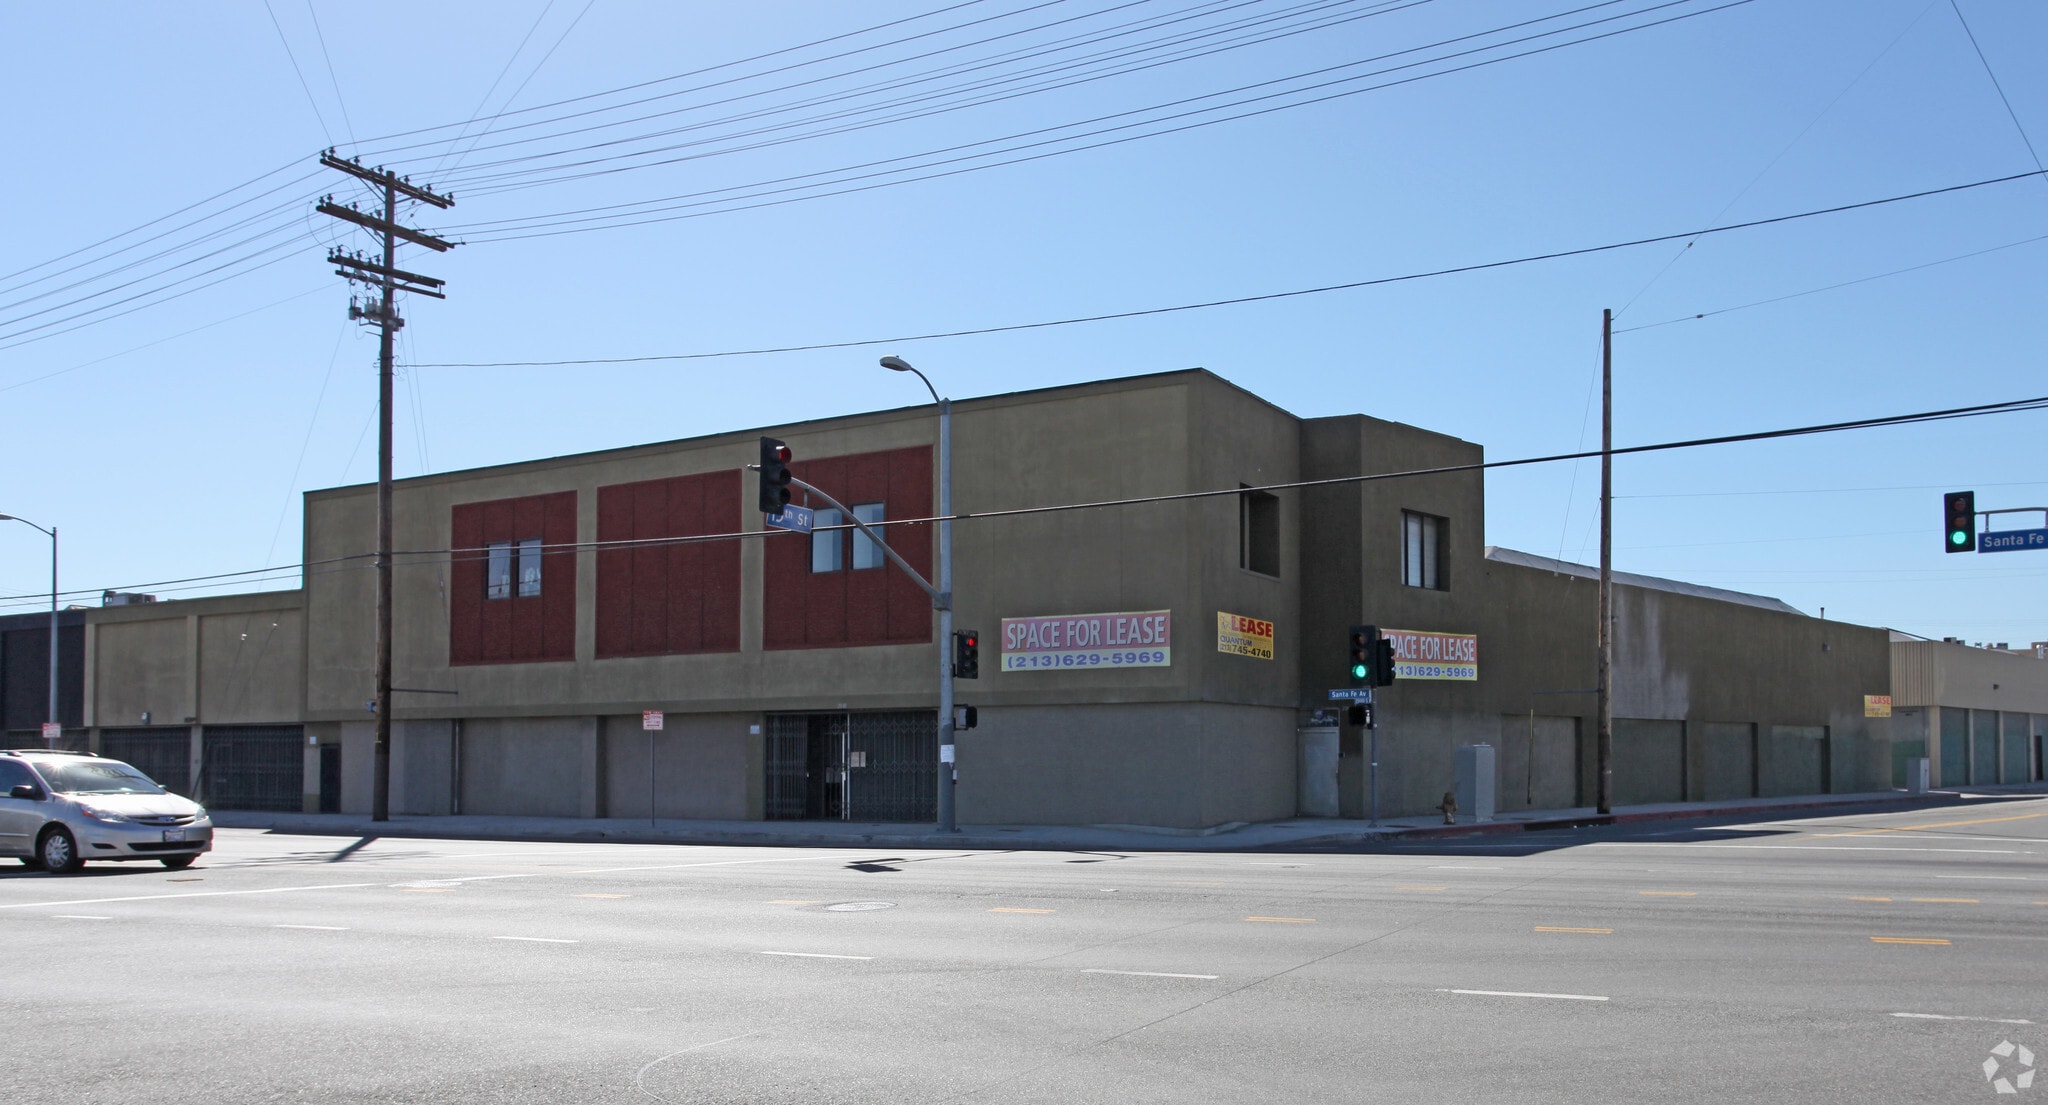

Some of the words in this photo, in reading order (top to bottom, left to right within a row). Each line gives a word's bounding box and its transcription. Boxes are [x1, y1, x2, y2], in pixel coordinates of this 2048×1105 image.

[797, 513, 808, 527] St
[1984, 535, 2024, 548] Santa
[2028, 533, 2044, 545] Fe
[1007, 621, 1062, 650] SPACE
[1066, 619, 1102, 648] FOR
[1106, 616, 1166, 646] LEASE
[1231, 615, 1273, 638] LEASE
[1220, 635, 1253, 647] QUANTUM
[1384, 633, 1417, 660] PACE
[1420, 636, 1441, 660] FOR
[1443, 637, 1475, 662] LEASE
[1007, 651, 1166, 669] (213)629-5969
[1393, 665, 1475, 678] 13)629-5969
